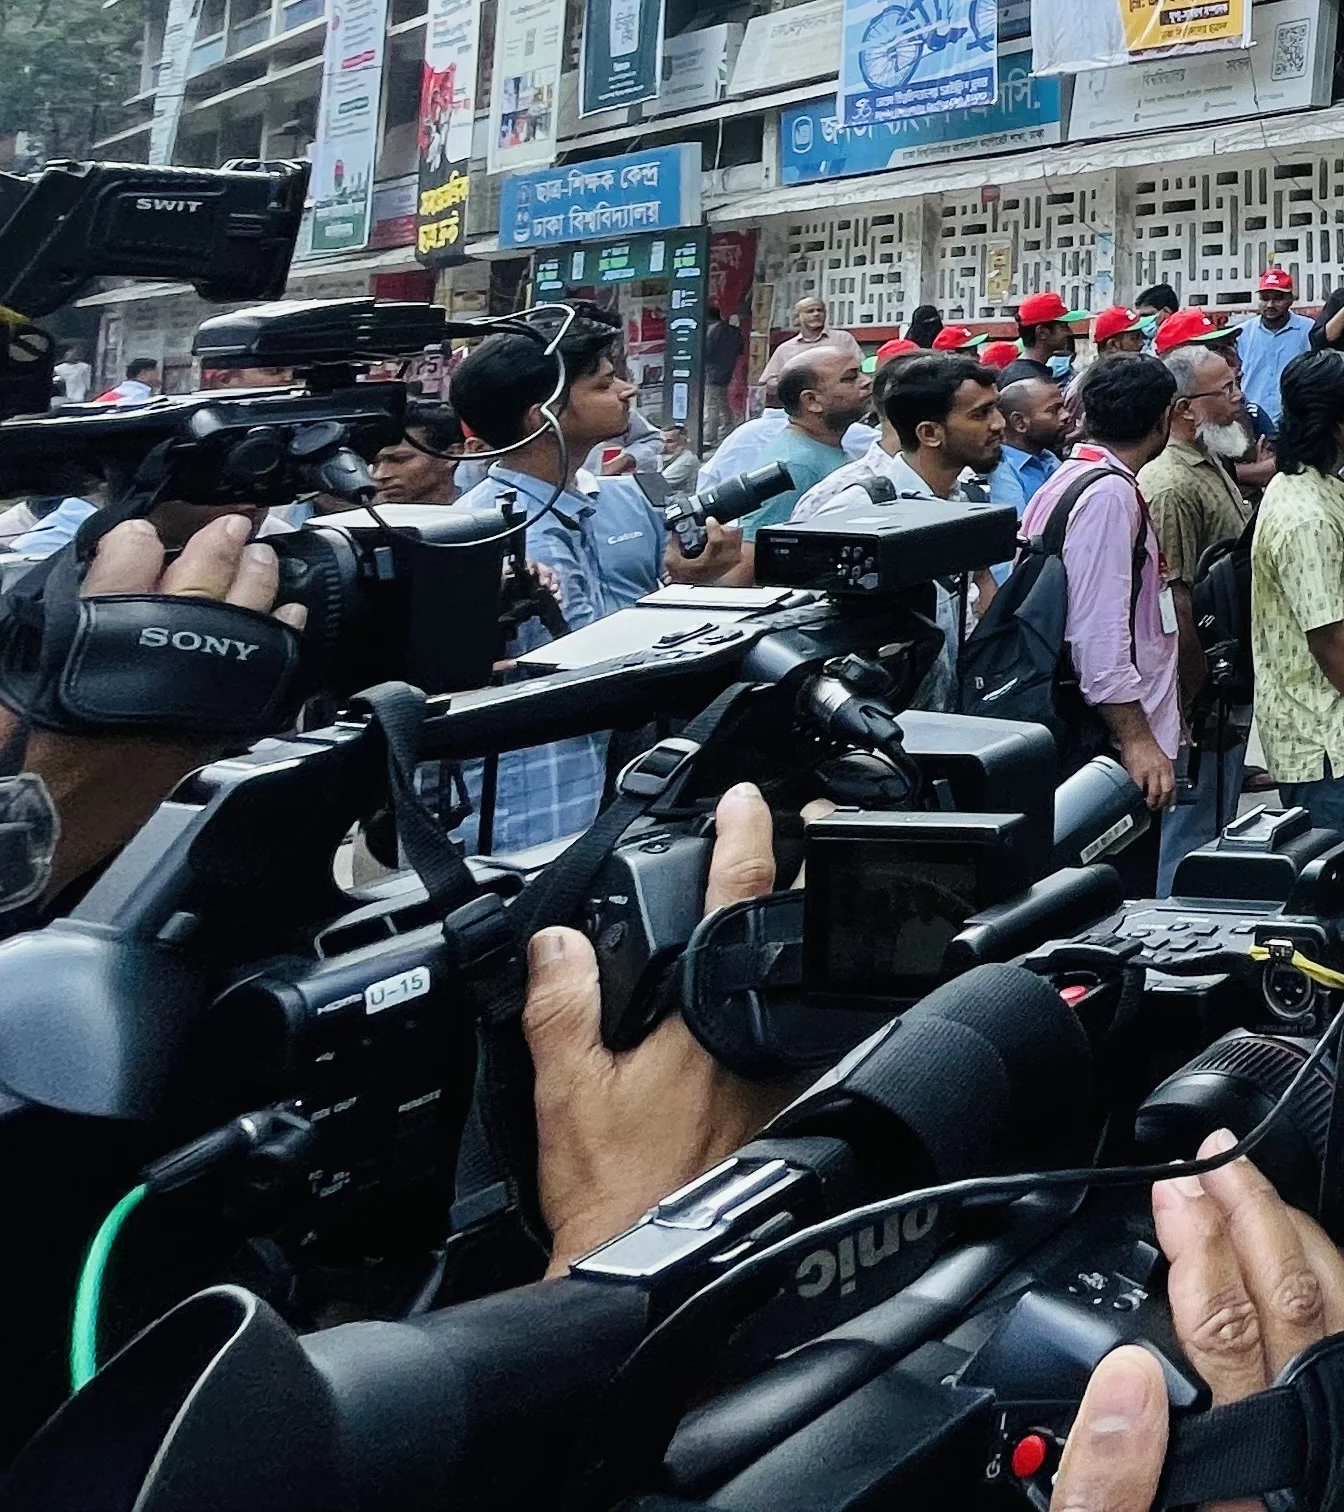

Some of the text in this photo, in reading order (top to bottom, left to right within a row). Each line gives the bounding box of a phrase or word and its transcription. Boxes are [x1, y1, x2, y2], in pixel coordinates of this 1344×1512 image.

[534, 160, 661, 205] ছাত্র-শিক্ষক কেন্দ্র
[136, 196, 205, 215] SWIT
[531, 198, 663, 240] ঢাকা বিশ্ববিদ্যালয়
[138, 625, 261, 662] SONY
[369, 973, 425, 1007] U-15
